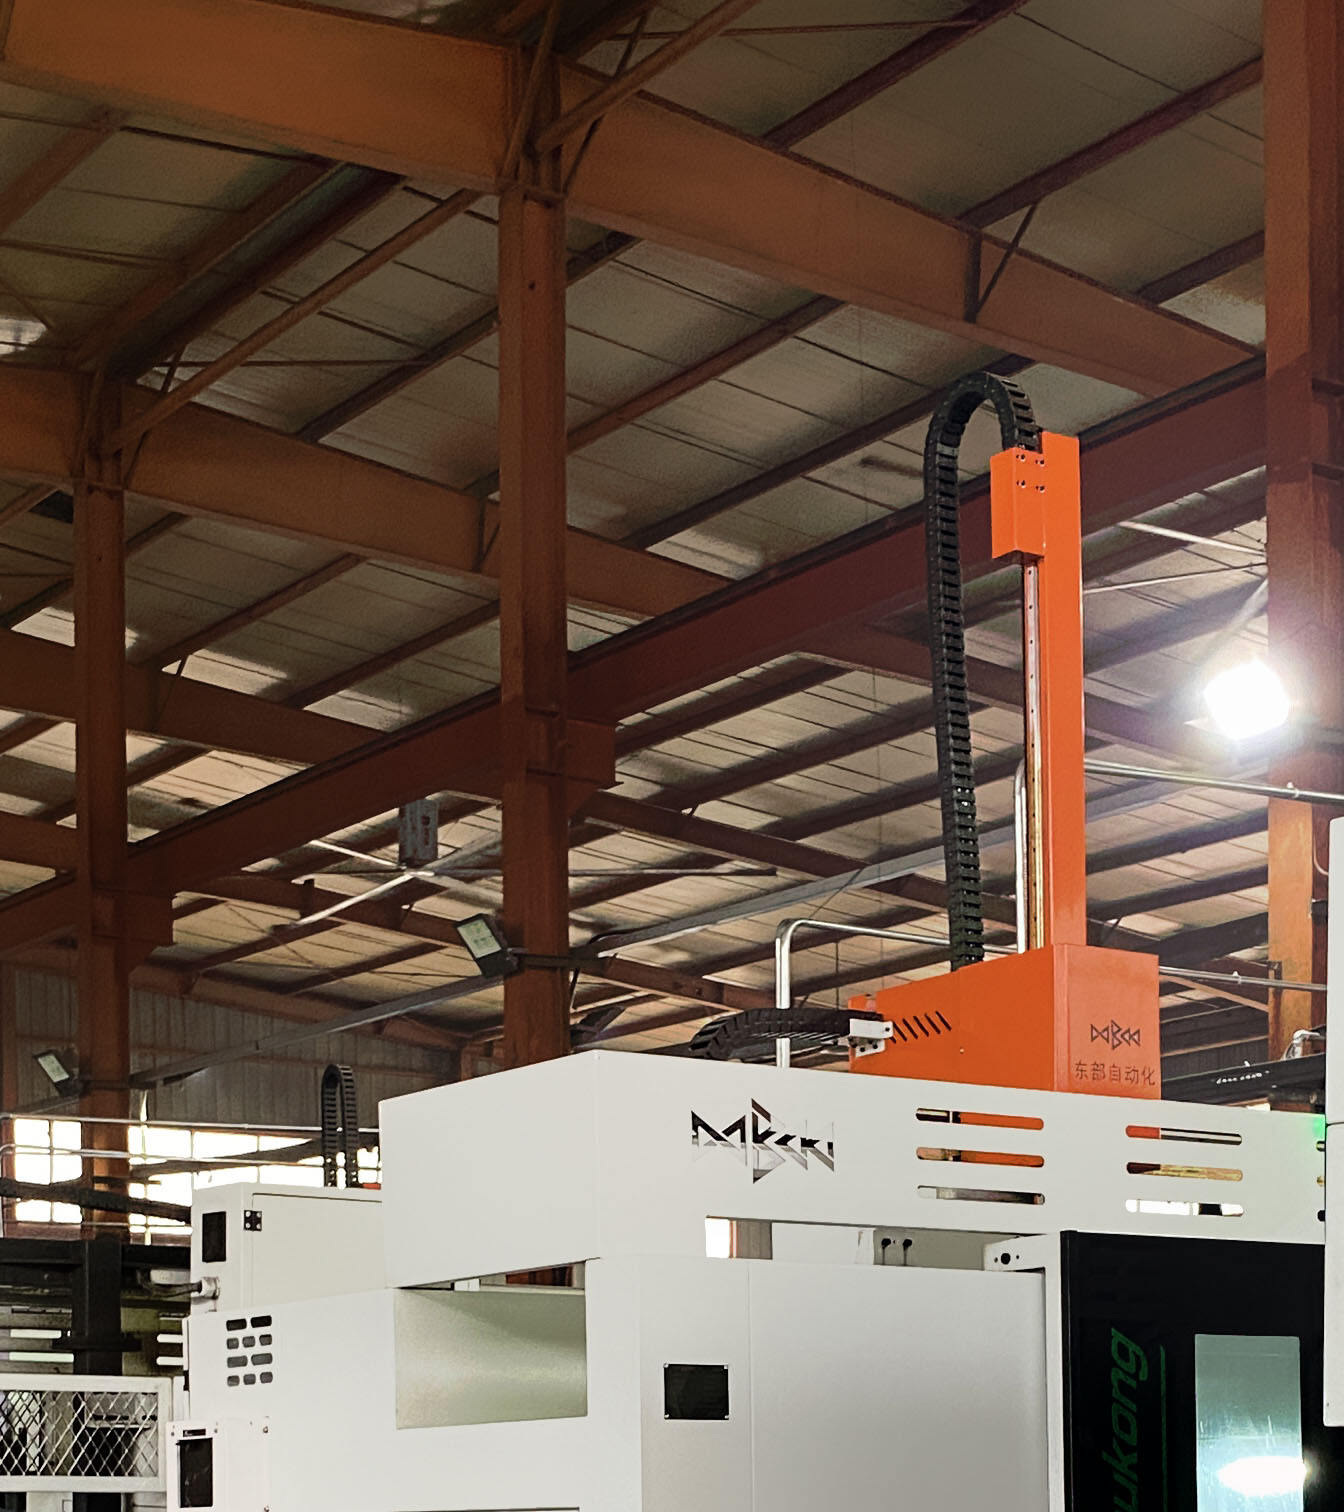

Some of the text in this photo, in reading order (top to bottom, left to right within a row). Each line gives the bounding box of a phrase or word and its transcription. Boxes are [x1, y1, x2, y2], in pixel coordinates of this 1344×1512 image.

[1074, 1059, 1156, 1086] 东部自动化
